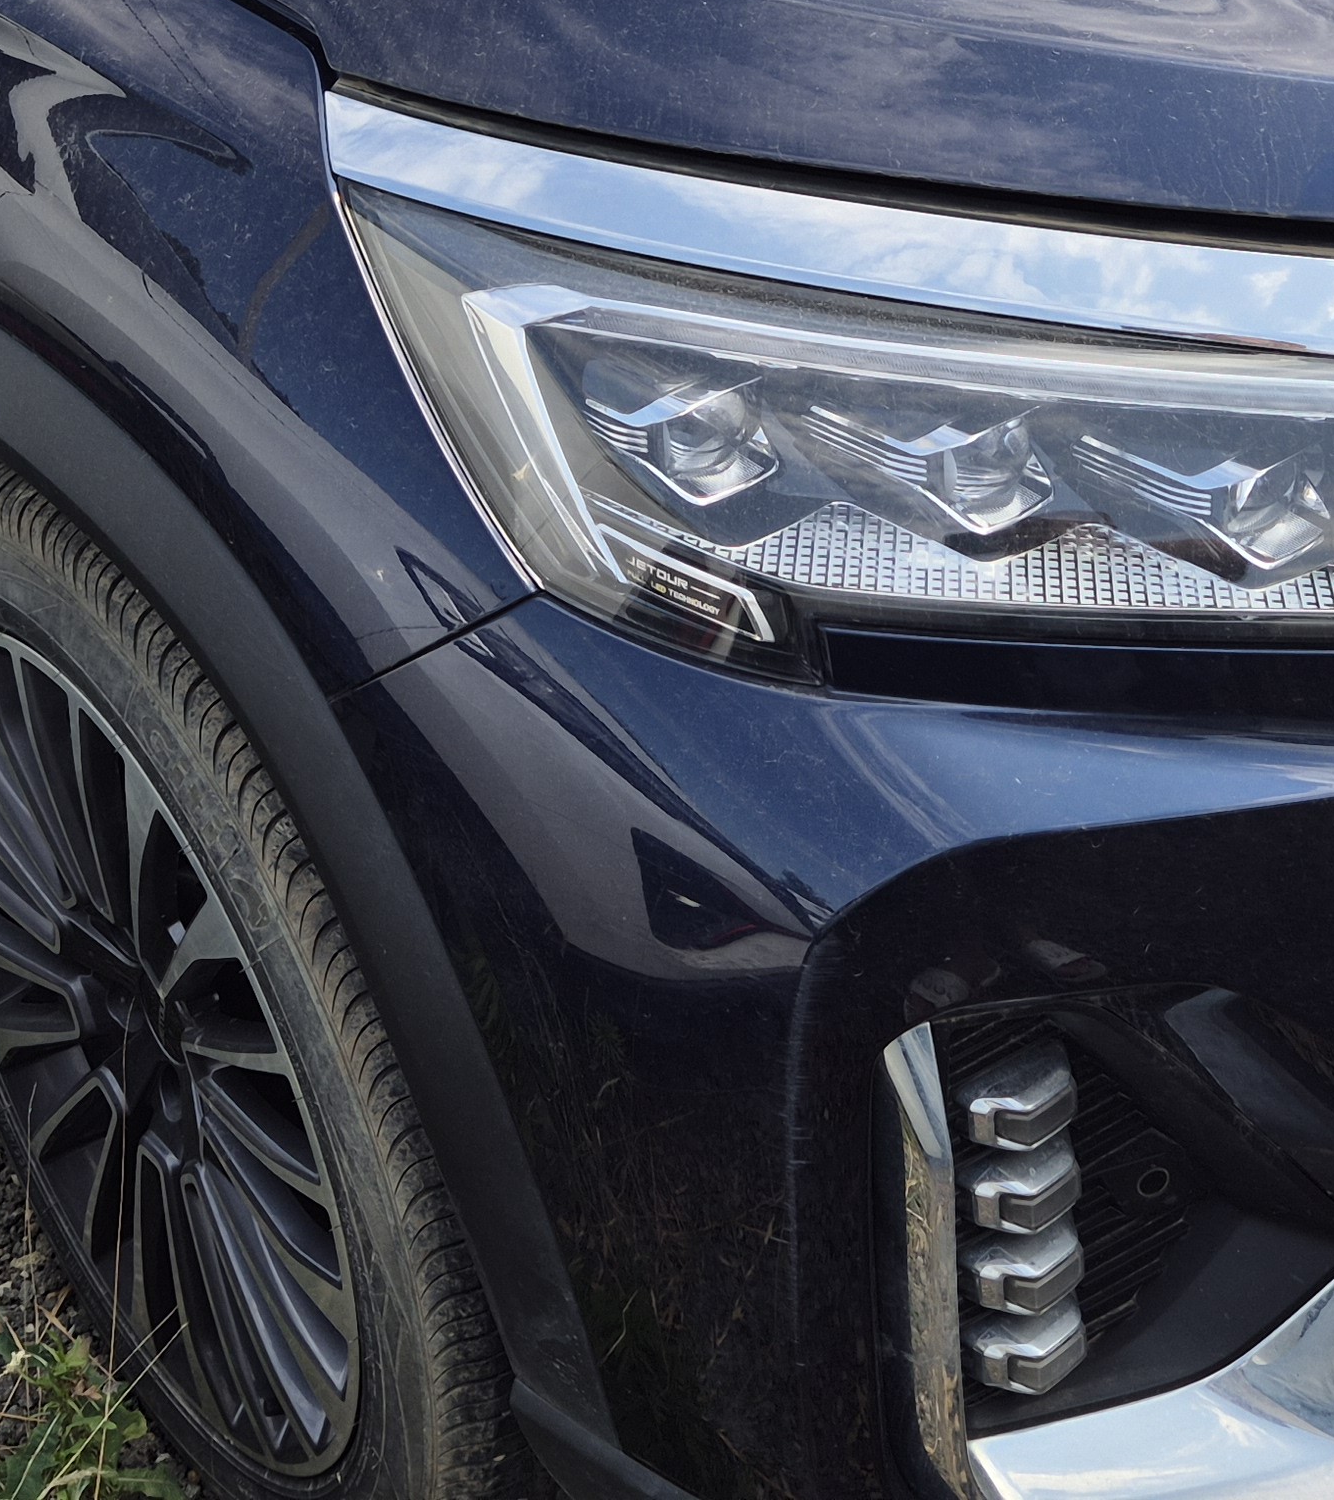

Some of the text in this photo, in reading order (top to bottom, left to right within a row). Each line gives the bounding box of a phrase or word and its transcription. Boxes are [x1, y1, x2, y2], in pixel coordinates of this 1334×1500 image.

[626, 556, 689, 589] JETOUR
[651, 580, 667, 594] LED
[668, 588, 720, 616] TECHNOLOGY
